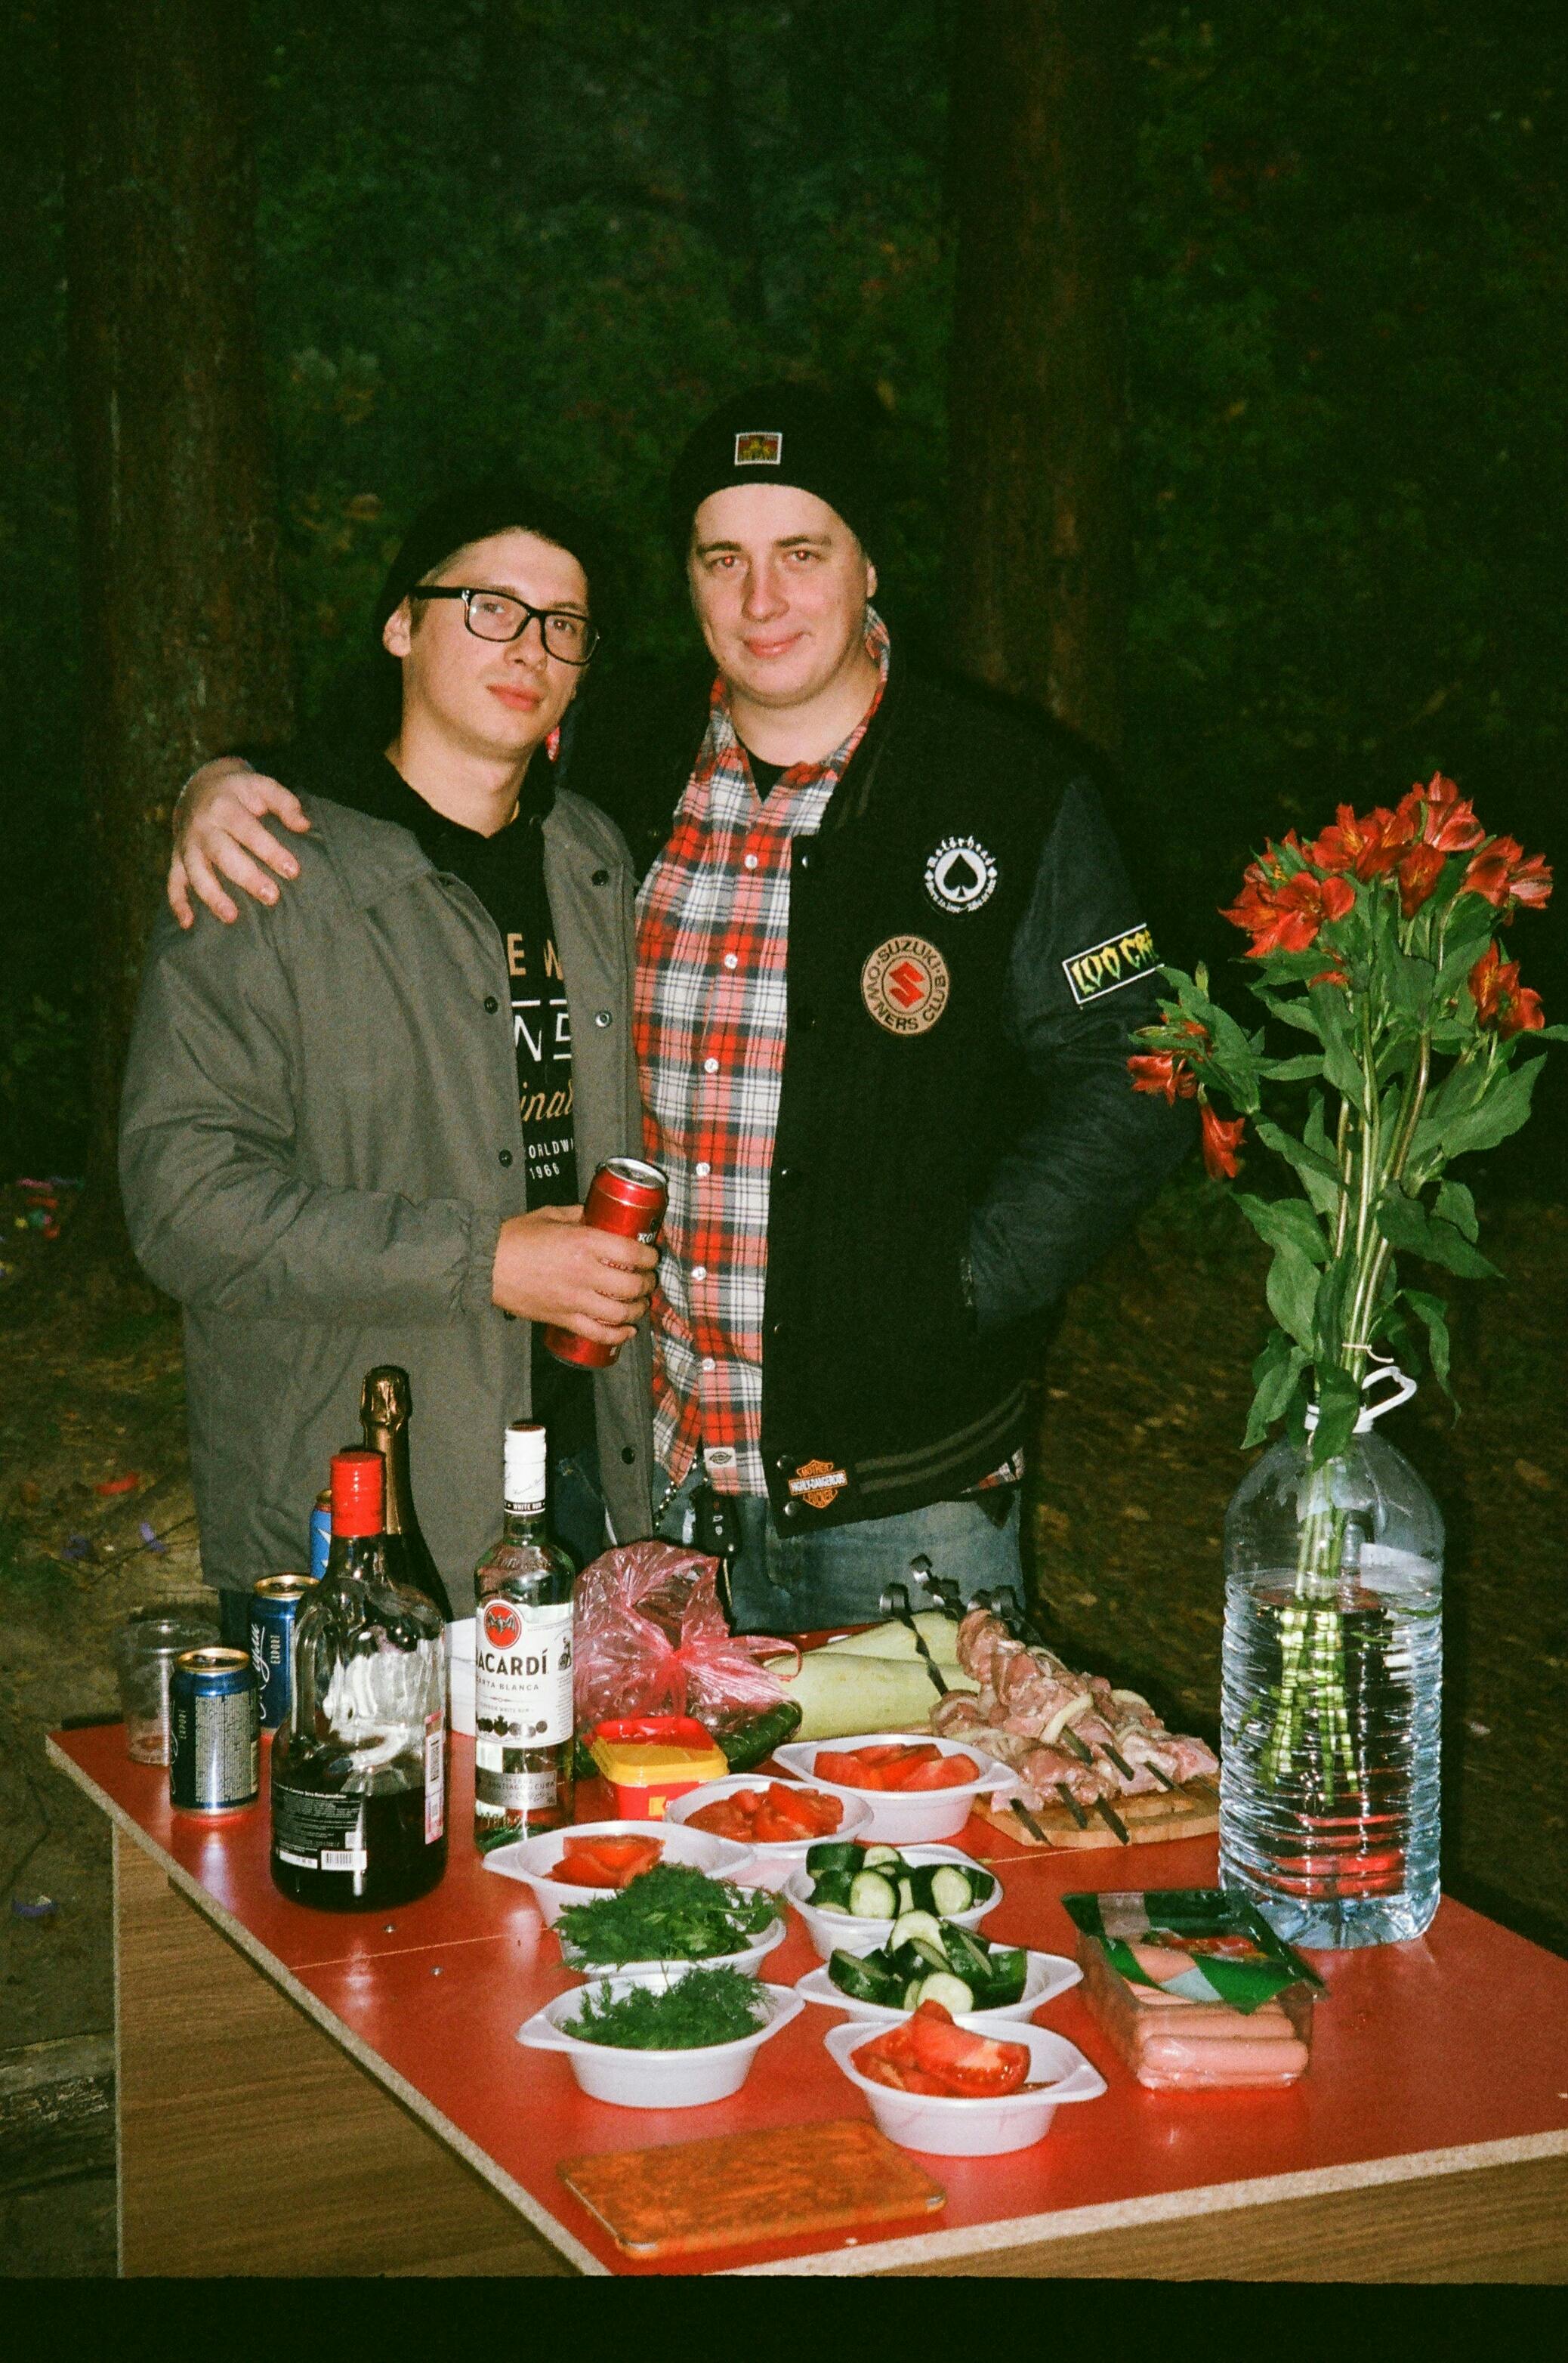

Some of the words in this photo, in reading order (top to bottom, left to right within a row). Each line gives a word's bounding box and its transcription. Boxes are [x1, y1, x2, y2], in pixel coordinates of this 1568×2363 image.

[878, 941, 941, 970] SUZUKI
[866, 967, 919, 1030] OWNERS
[923, 975, 946, 1022] CLUB
[529, 1162, 560, 1179] 1966
[513, 1503, 531, 1511] WHITE
[270, 1635, 281, 1664] EXPORT
[476, 1648, 548, 1676] ACARDÍ
